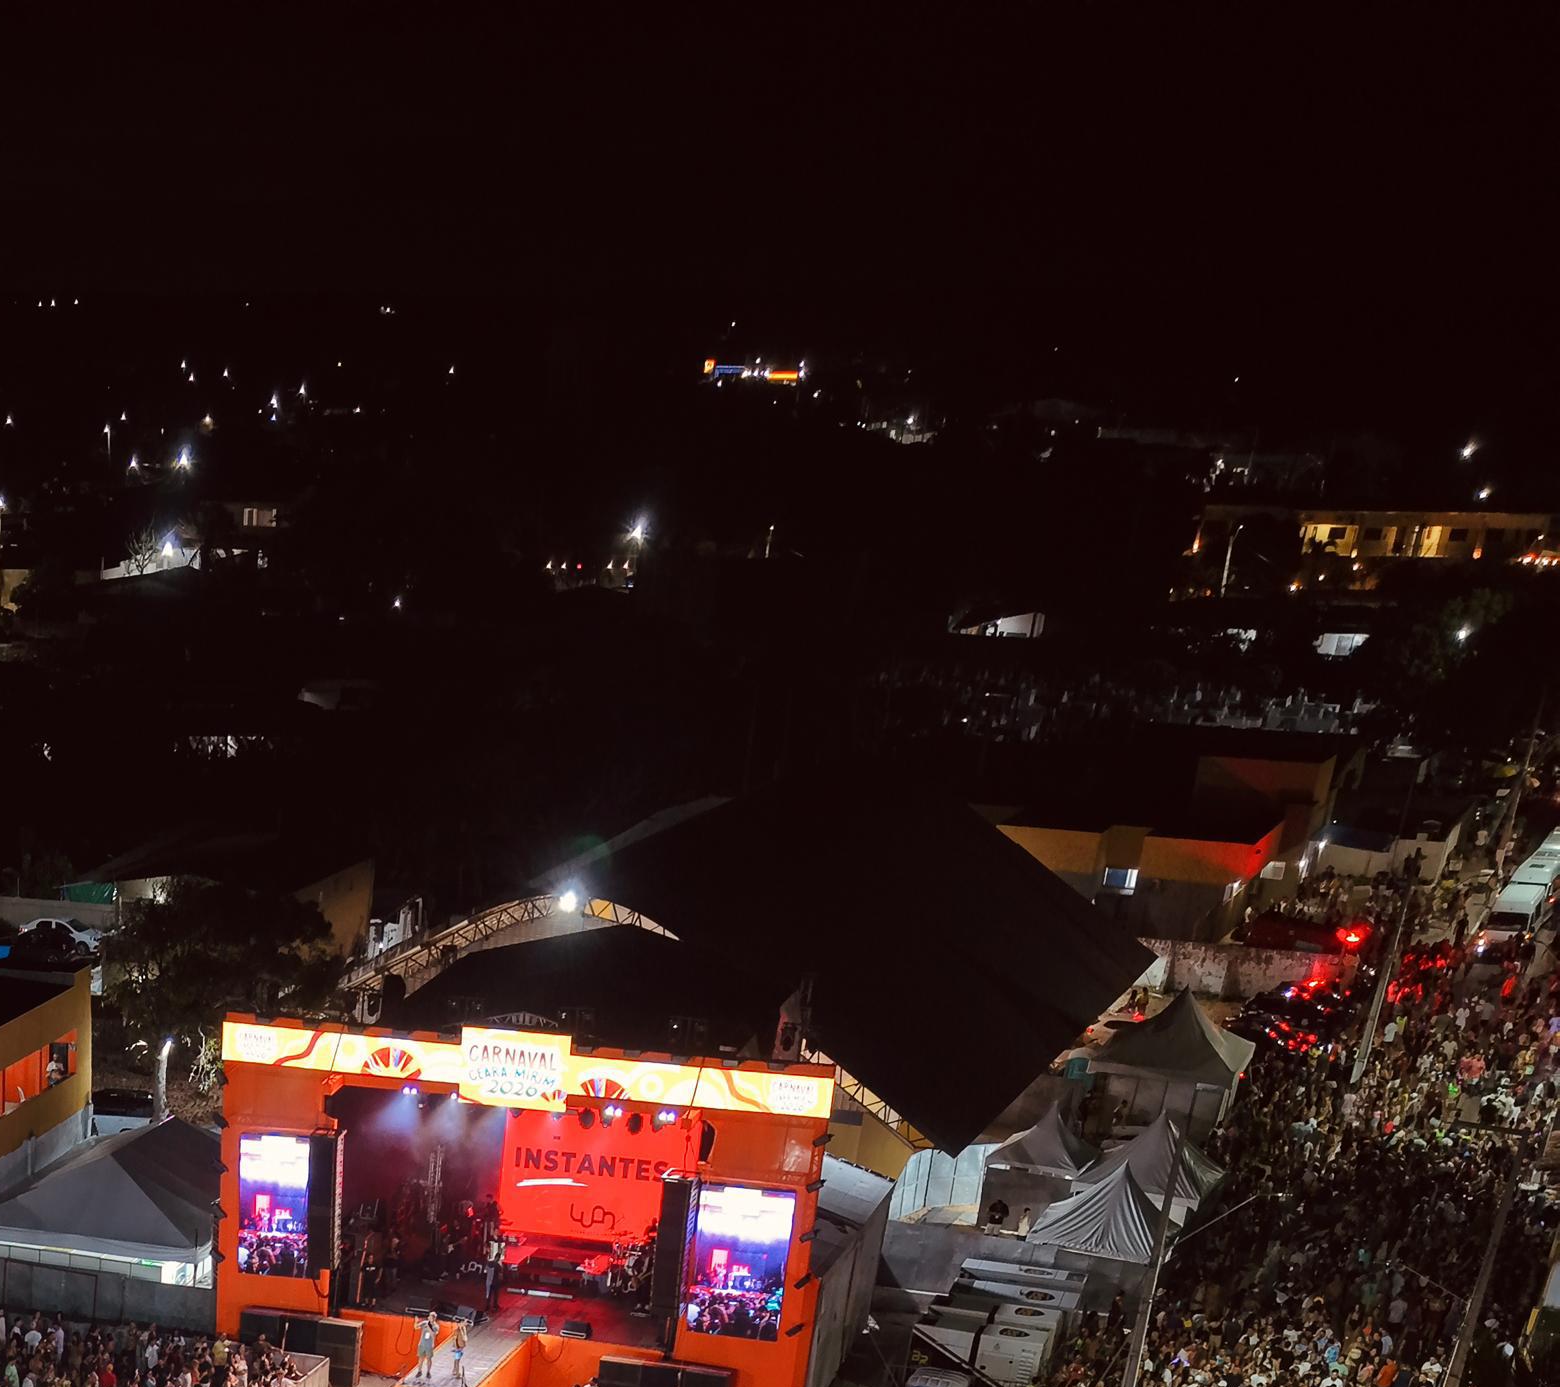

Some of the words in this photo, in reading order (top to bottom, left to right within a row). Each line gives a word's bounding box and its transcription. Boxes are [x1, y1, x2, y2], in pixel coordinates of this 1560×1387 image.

[468, 1044, 557, 1071] CARNAVAL
[515, 1067, 555, 1088] MIRIM
[515, 1146, 669, 1183] INSTANTES
